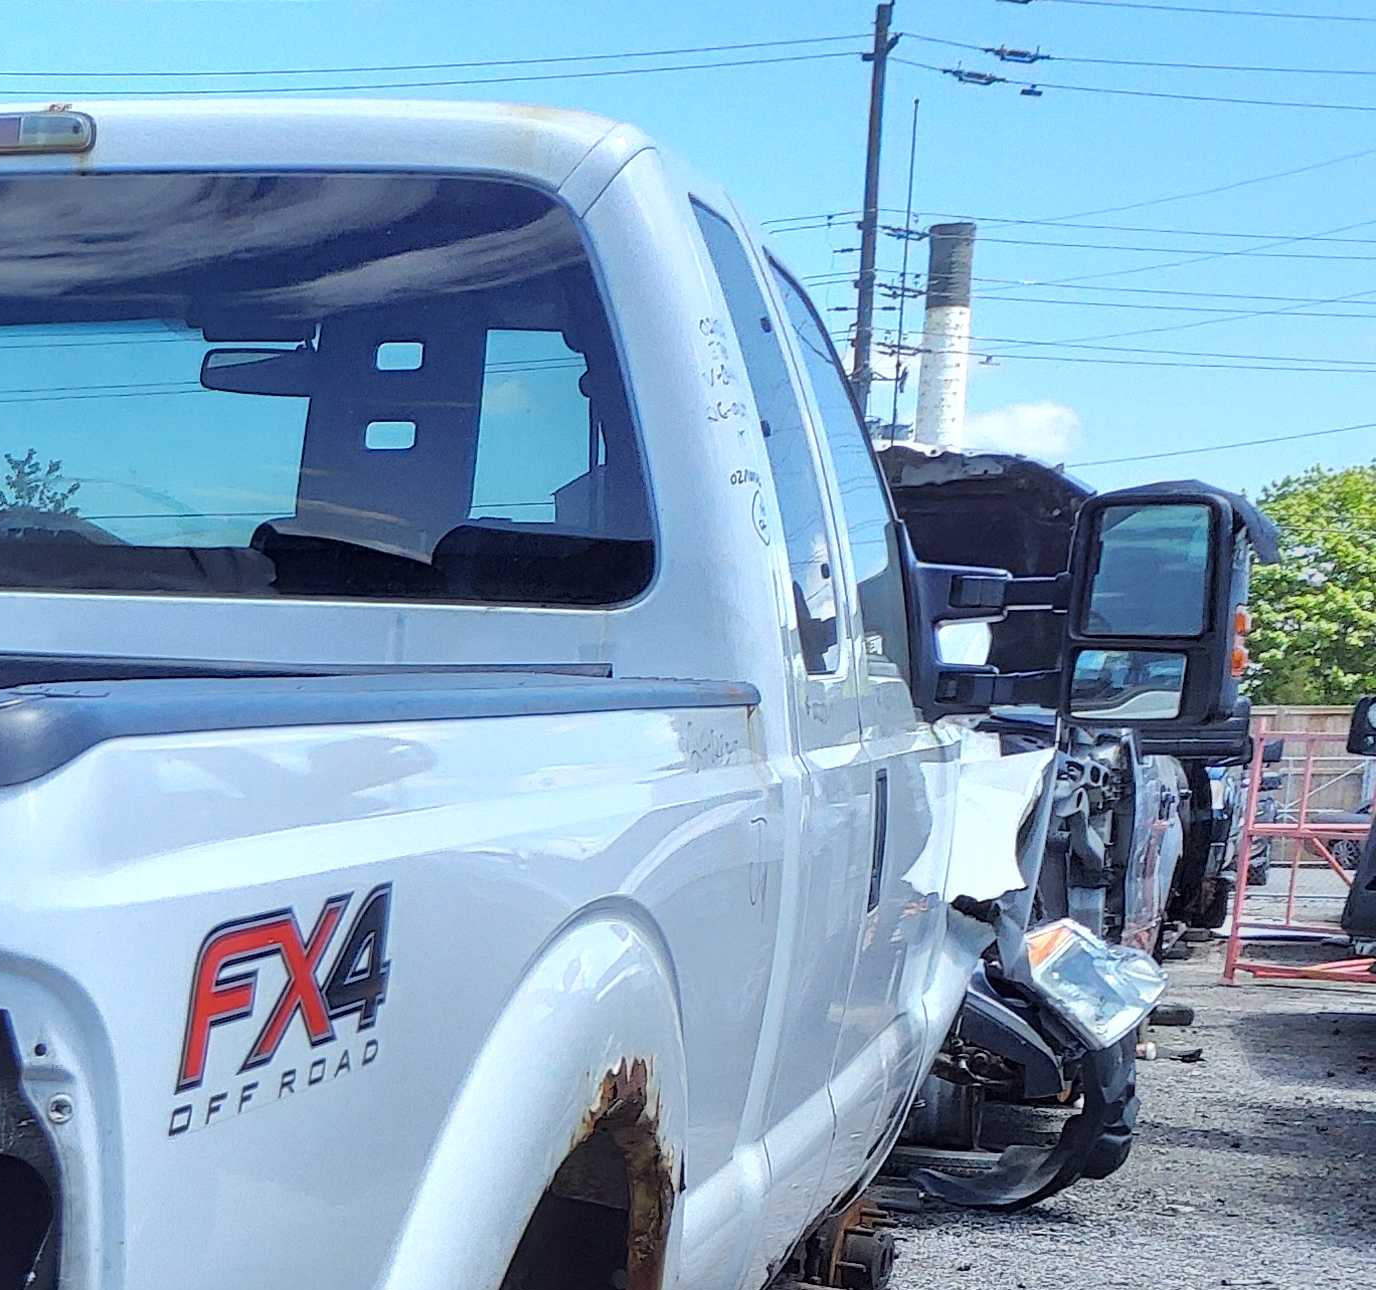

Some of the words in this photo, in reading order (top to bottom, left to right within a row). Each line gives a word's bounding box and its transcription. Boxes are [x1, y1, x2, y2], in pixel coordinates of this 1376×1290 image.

[174, 880, 393, 1095] FX4
[168, 1081, 259, 1137] OFF
[277, 1038, 378, 1099] ROAD
